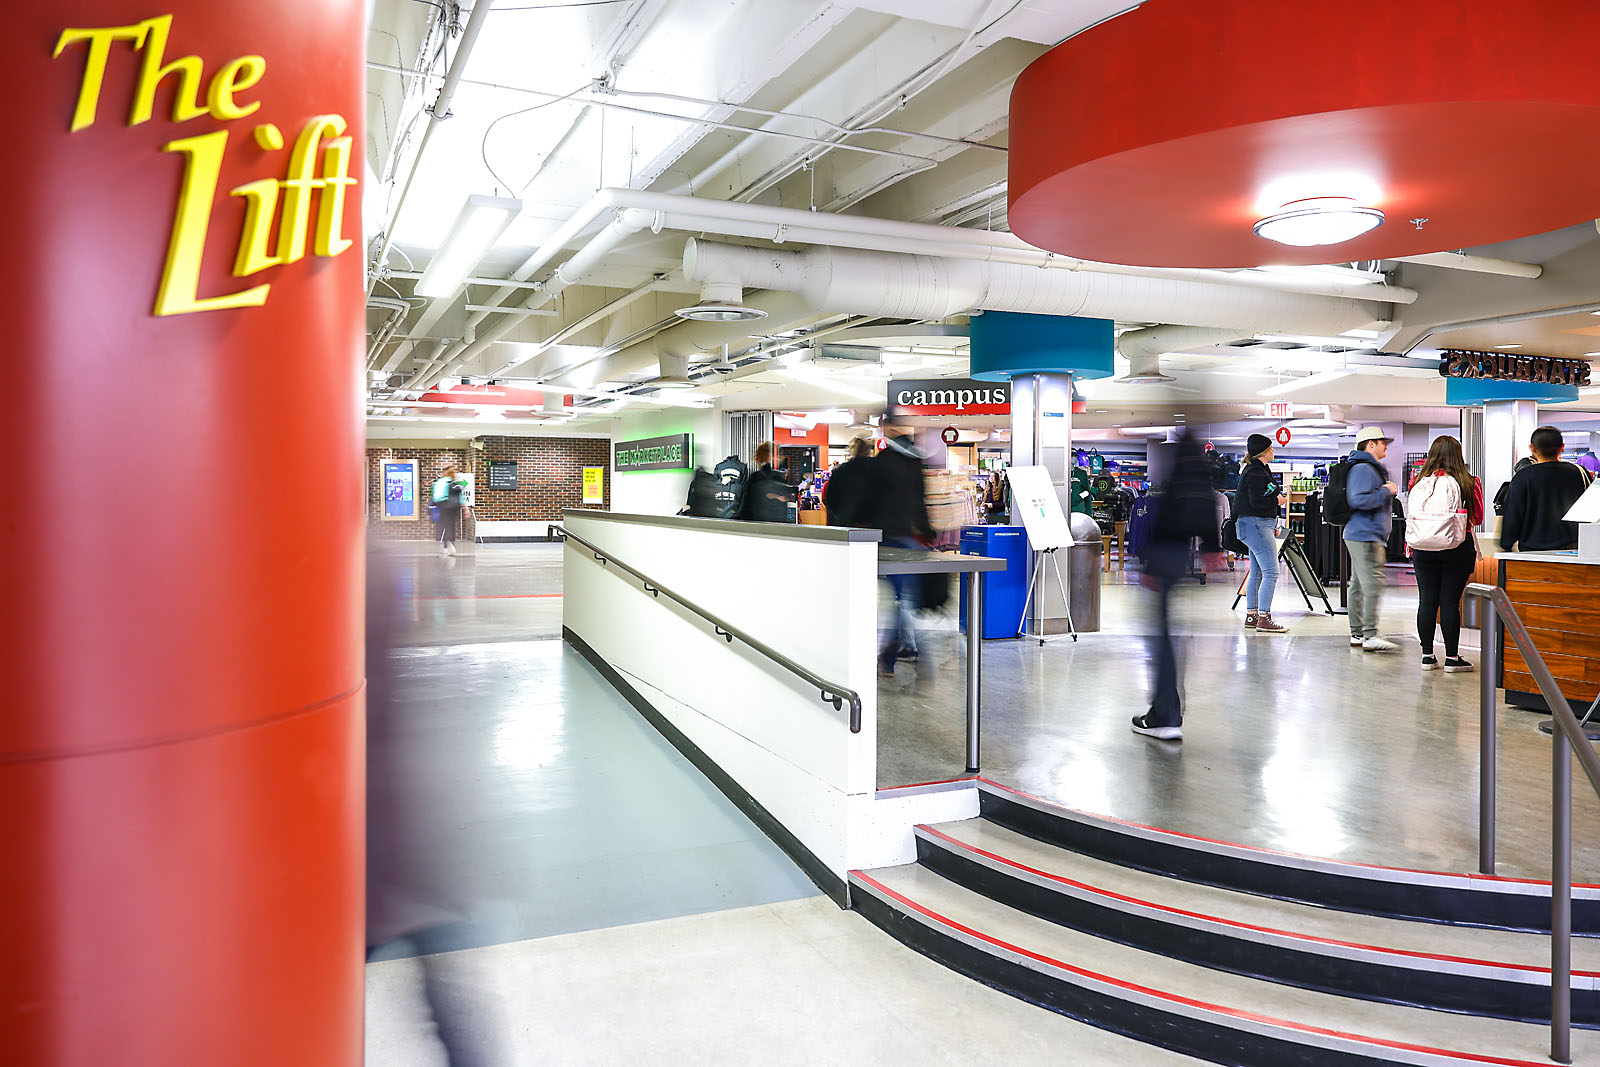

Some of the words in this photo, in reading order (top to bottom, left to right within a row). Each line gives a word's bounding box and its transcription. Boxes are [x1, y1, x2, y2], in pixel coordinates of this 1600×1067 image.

[53, 14, 266, 133] The
[151, 114, 357, 316] Lift
[897, 388, 1006, 410] campus
[1271, 403, 1288, 416] EXIT
[616, 450, 629, 466] THE
[630, 444, 682, 466] MARKETPLACE
